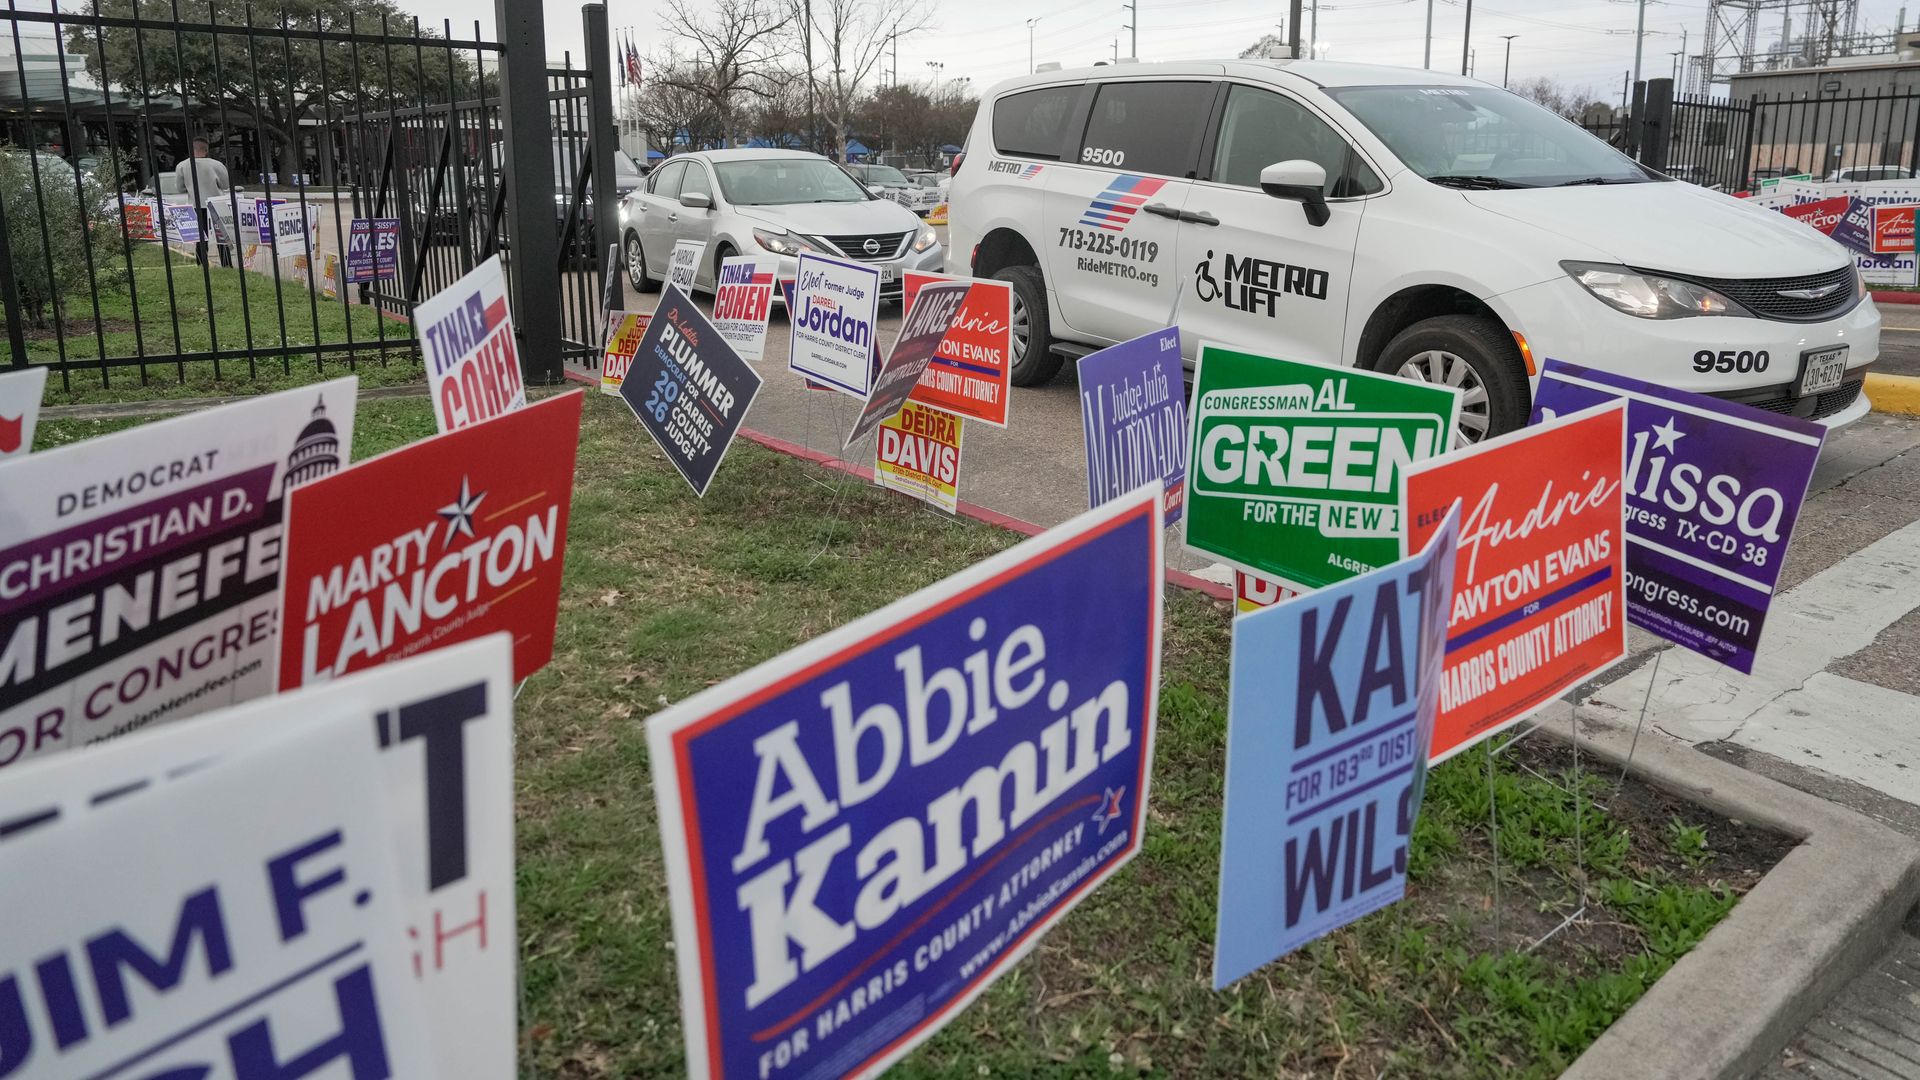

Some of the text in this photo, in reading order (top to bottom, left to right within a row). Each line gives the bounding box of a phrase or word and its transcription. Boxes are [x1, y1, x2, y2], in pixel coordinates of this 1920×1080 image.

[988, 160, 1022, 174] METRO
[1082, 147, 1124, 166] 9500
[353, 222, 370, 230] YSIDR
[1058, 228, 1158, 262] 713-225-0119
[720, 265, 742, 284] TINA
[801, 271, 864, 300] Elect Former Judge
[1078, 257, 1158, 287] RideMETRO.org
[1224, 254, 1329, 300] METRO
[714, 286, 770, 321] COHEN
[798, 296, 869, 348] Jordan
[812, 294, 836, 310] DARRELL
[901, 292, 964, 342] LANGE
[951, 306, 1008, 334] drie
[1224, 282, 1281, 318] LIFT
[425, 305, 470, 375] TINA
[740, 323, 764, 334] CONGRESS
[804, 333, 818, 344] HARRIS
[818, 338, 835, 350] COUNTY
[835, 341, 853, 356] DISTRICT
[854, 350, 866, 360] CLERK
[1160, 336, 1176, 351] Elect
[442, 322, 520, 430] COHEN
[654, 344, 688, 384] DEMOCRAT
[660, 323, 735, 420] PLUMMER
[963, 343, 1000, 364] EVANS
[1693, 350, 1770, 373] 9500
[1820, 353, 1836, 362] TEXAS
[644, 390, 669, 422] 26
[655, 370, 678, 403] 20
[685, 380, 700, 400] FOR
[937, 376, 962, 398] COUNTY
[963, 382, 1000, 407] ATTORNEY
[1110, 361, 1169, 427] Judge Julia
[1204, 378, 1356, 411] CONGRESSMAN AL
[672, 407, 712, 456] COUNTY
[678, 392, 714, 438] HARRIS
[902, 408, 956, 445] DEDRA
[664, 422, 696, 461] JUDGE
[882, 428, 956, 484] DAVIS
[1084, 385, 1186, 508] MALDONADO
[1201, 424, 1434, 494] GREEN
[56, 450, 219, 518] DEMOCRAT
[1164, 490, 1182, 512] Court
[1626, 415, 1784, 544] lissa
[1243, 502, 1278, 524] FOR
[1280, 504, 1318, 527] THE
[1328, 506, 1382, 531] NEW
[1456, 470, 1620, 585] Audrie
[1624, 505, 1768, 568] gress TX-CD 38
[0, 487, 253, 600] CHRISTIAN D.
[302, 505, 558, 682] LANCTON
[306, 521, 438, 624] MARTY
[1447, 529, 1610, 628] AWTON EVANS
[0, 523, 281, 688] MENEFE
[1524, 601, 1540, 617] FOR
[1626, 570, 1750, 636] ongress.com
[1440, 648, 1496, 714] HARRIS
[1498, 622, 1551, 686] COUNTY
[1554, 591, 1612, 658] ATTORNEY
[0, 607, 278, 770] OR CONGRE
[88, 659, 262, 747] hristianMenefee.com
[732, 617, 1046, 874] Abbie
[1285, 771, 1322, 812] FOR
[1378, 728, 1415, 770] DIST
[738, 679, 1131, 1011] Kamin
[264, 826, 373, 945] F.
[960, 830, 1128, 980] www.AbbieKamin.com
[758, 1028, 809, 1080] FOR
[816, 960, 909, 1040] HARRIS
[914, 894, 994, 972] COUNTY
[998, 822, 1085, 908] ATTORNEY
